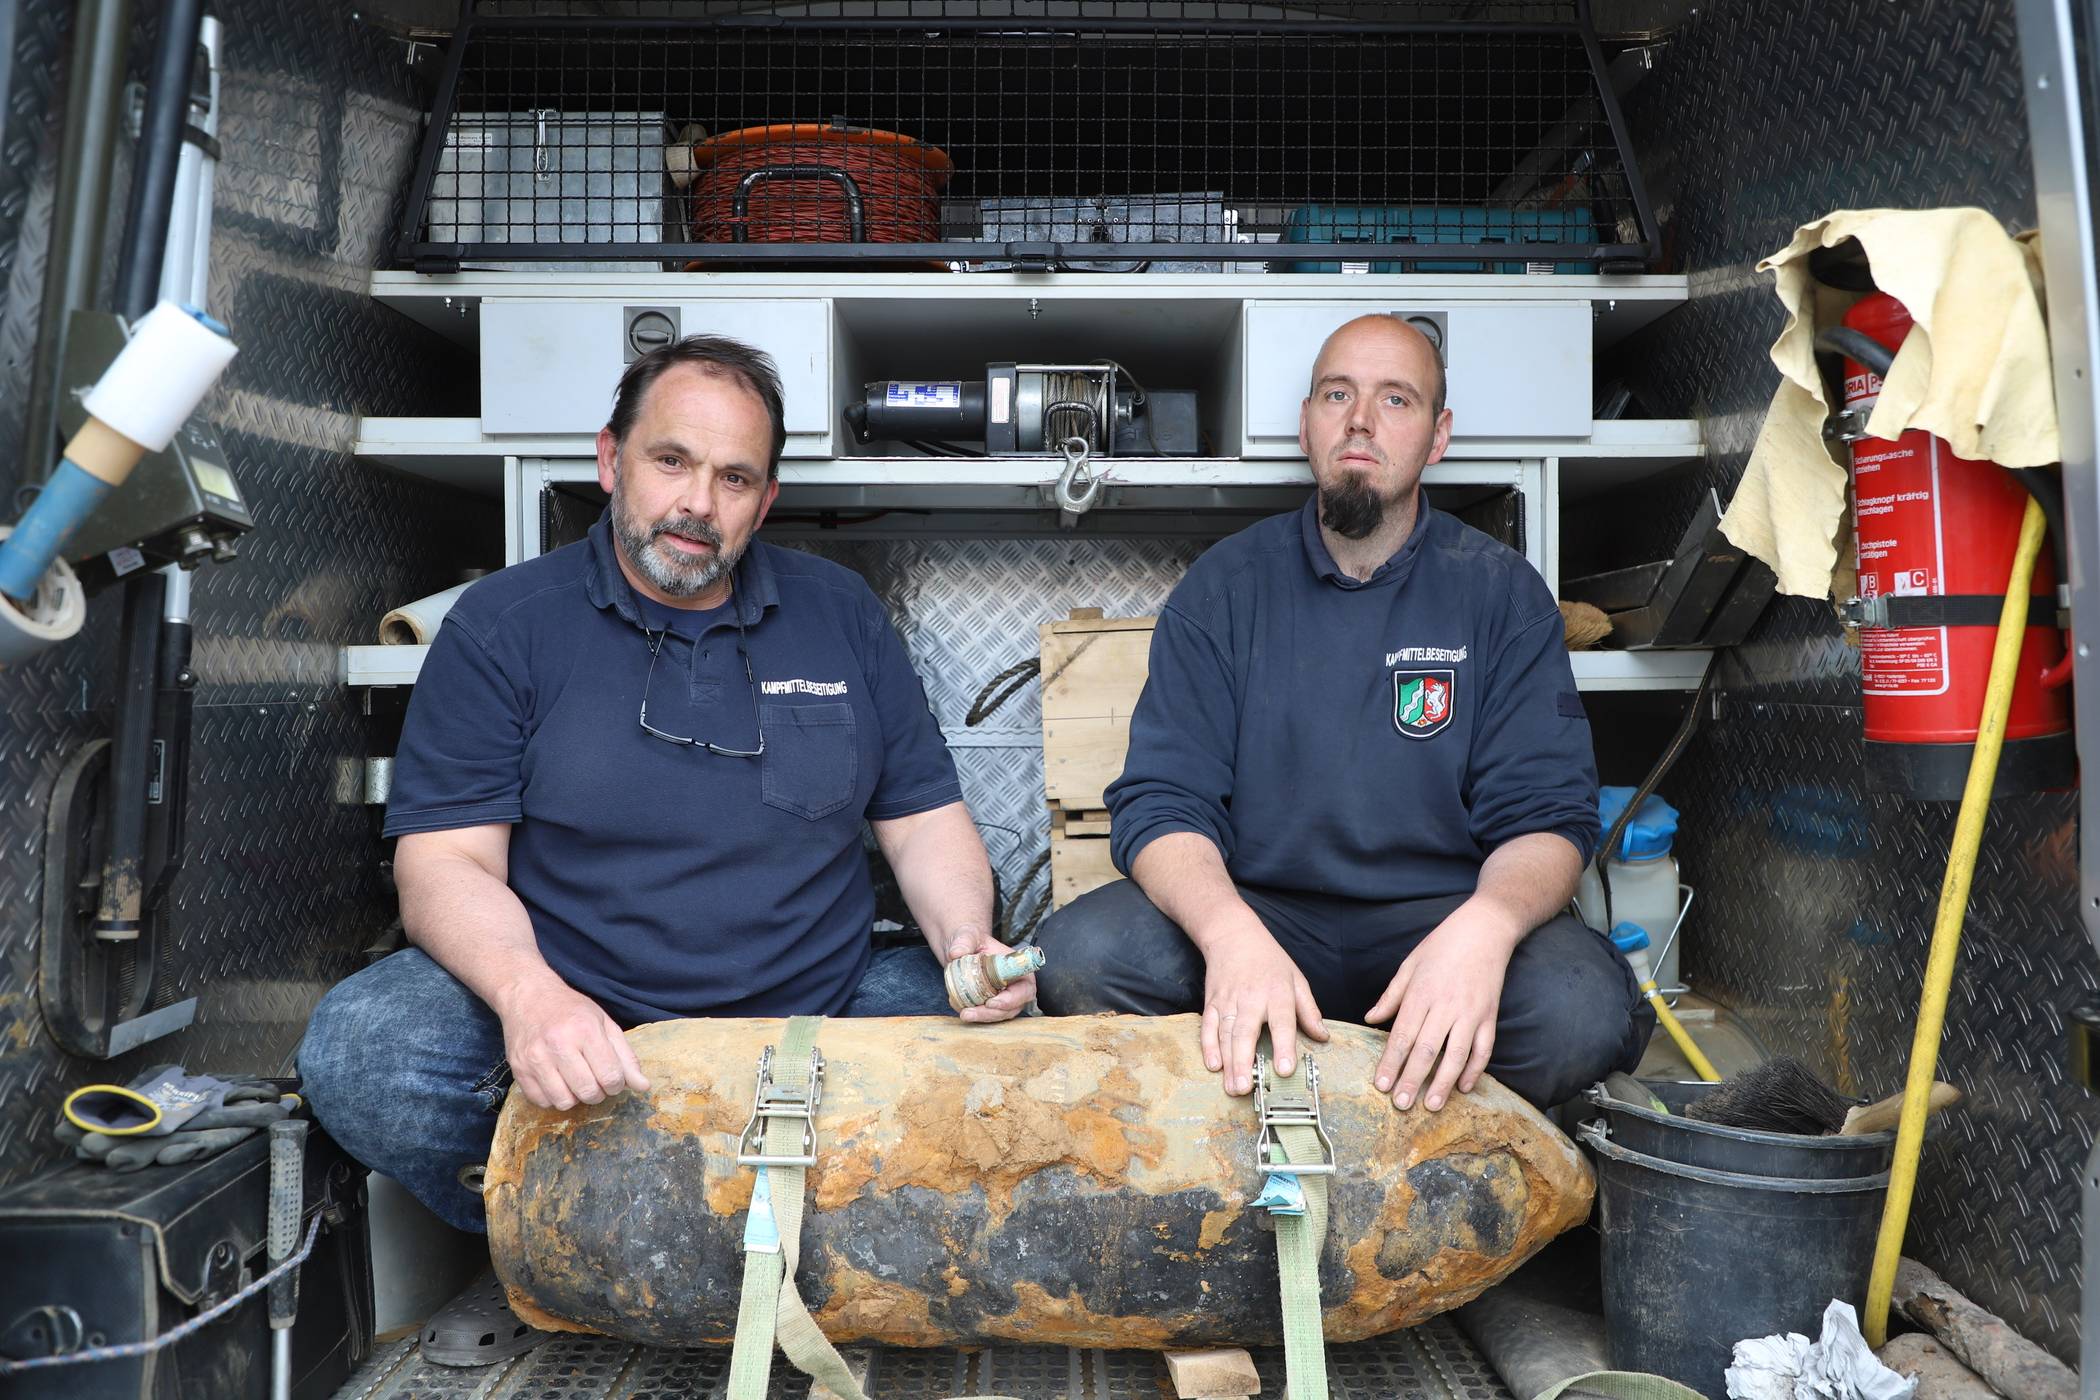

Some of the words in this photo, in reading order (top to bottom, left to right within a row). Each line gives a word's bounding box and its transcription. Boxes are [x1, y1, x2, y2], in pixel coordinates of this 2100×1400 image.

[1897, 491, 1929, 502] kräftig
[1868, 575, 1876, 589] B
[1912, 571, 1925, 586] C
[761, 679, 847, 696] KAMPFMITTELBESEITIGUNG
